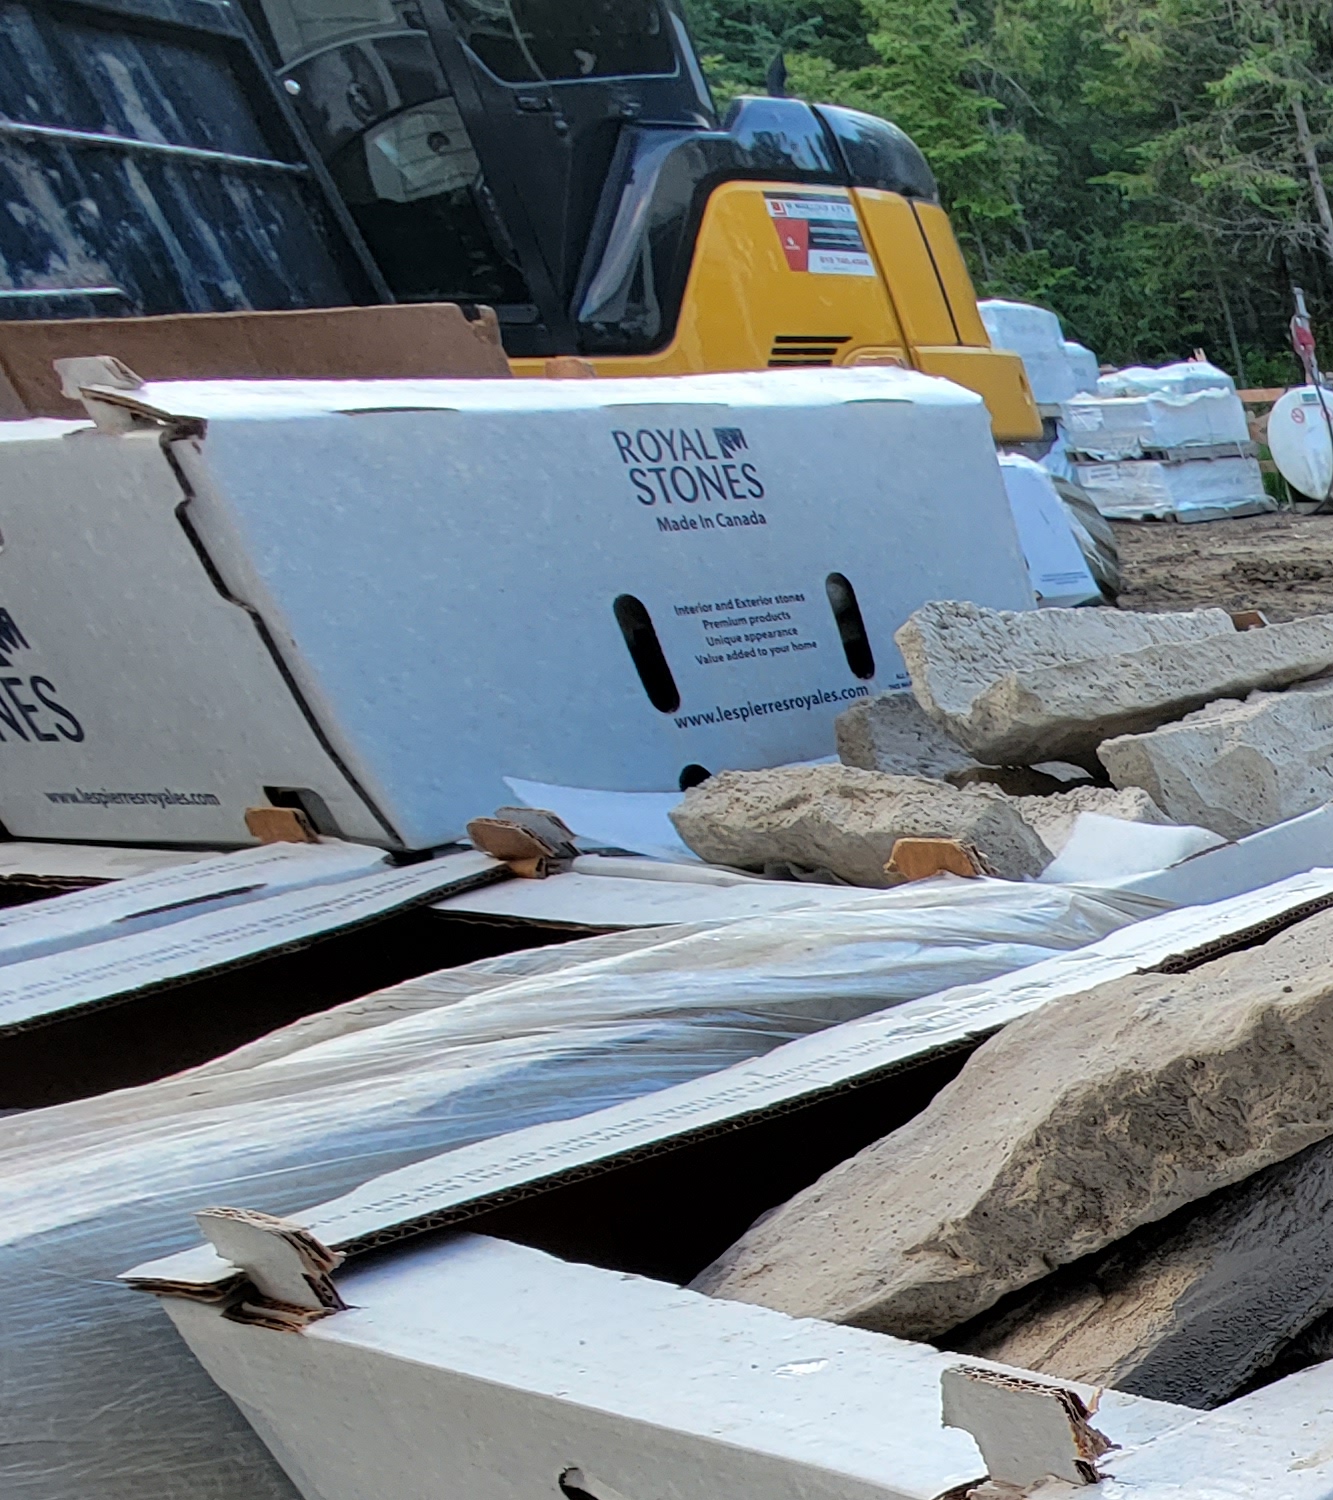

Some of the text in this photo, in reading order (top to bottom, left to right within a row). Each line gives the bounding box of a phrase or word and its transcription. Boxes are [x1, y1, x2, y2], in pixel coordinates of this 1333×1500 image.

[612, 428, 718, 464] ROYAL
[629, 463, 765, 506] STONES
[656, 510, 767, 532] Made In Canada
[673, 592, 806, 616] Interior and Exterior stones
[702, 611, 792, 630] Premium products
[705, 627, 799, 649] Unique appearance
[694, 640, 818, 665] Value added to your home
[674, 682, 869, 730] www.lespierresroyales.com
